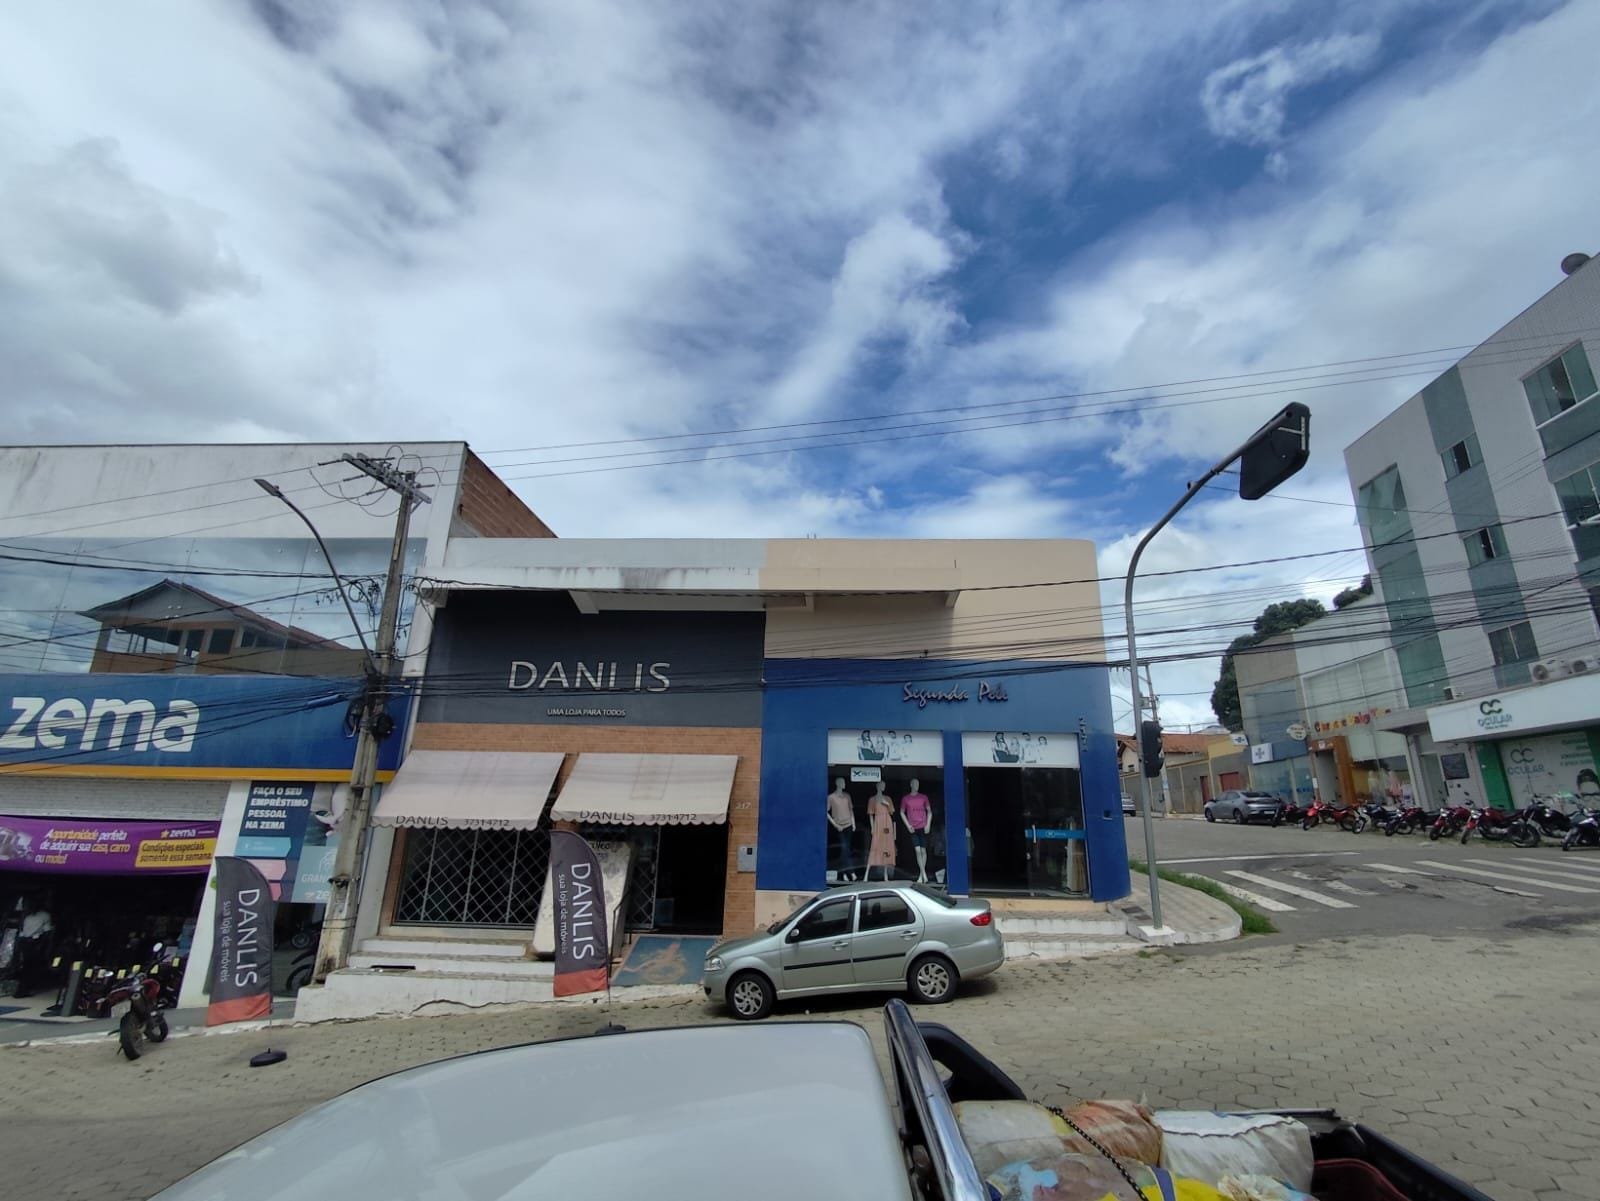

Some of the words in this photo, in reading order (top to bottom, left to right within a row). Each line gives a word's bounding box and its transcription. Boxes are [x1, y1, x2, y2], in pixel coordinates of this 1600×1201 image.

[508, 660, 671, 692] DANLIS
[903, 681, 968, 709] Segunda
[547, 708, 564, 716] UMA
[565, 708, 582, 716] LOJA
[583, 709, 602, 717] PARA
[603, 709, 626, 717] TODOS
[0, 695, 200, 753] zema
[1477, 713, 1513, 727] OCULAR
[1507, 764, 1544, 776] OCULAR
[253, 787, 275, 796] FAÇA
[276, 787, 283, 795] O
[284, 787, 303, 796] SEU
[250, 797, 309, 807] EMPRÉSTIMO
[247, 809, 287, 818] PESSOAL
[579, 810, 635, 821] DANLIS
[244, 821, 257, 829] NA
[259, 821, 285, 829] ZEMA
[396, 815, 448, 825] DANLIS
[97, 829, 127, 842] perfeita
[169, 829, 196, 838] zema
[39, 840, 50, 850] de
[78, 843, 91, 852] sua
[109, 844, 130, 852] carro
[142, 842, 175, 854] Condições
[175, 843, 205, 853] especiais
[34, 855, 45, 863] ou
[140, 854, 168, 862] somente
[169, 854, 184, 862] essa
[558, 873, 567, 889] sua
[558, 890, 569, 906] loja
[223, 900, 231, 917] sua
[560, 907, 569, 918] de
[571, 863, 594, 960] DANLIS
[220, 917, 232, 935] loja
[222, 936, 232, 947] de
[235, 888, 260, 987] DANLIS
[560, 921, 569, 954] móveis
[220, 949, 231, 982] móveis
